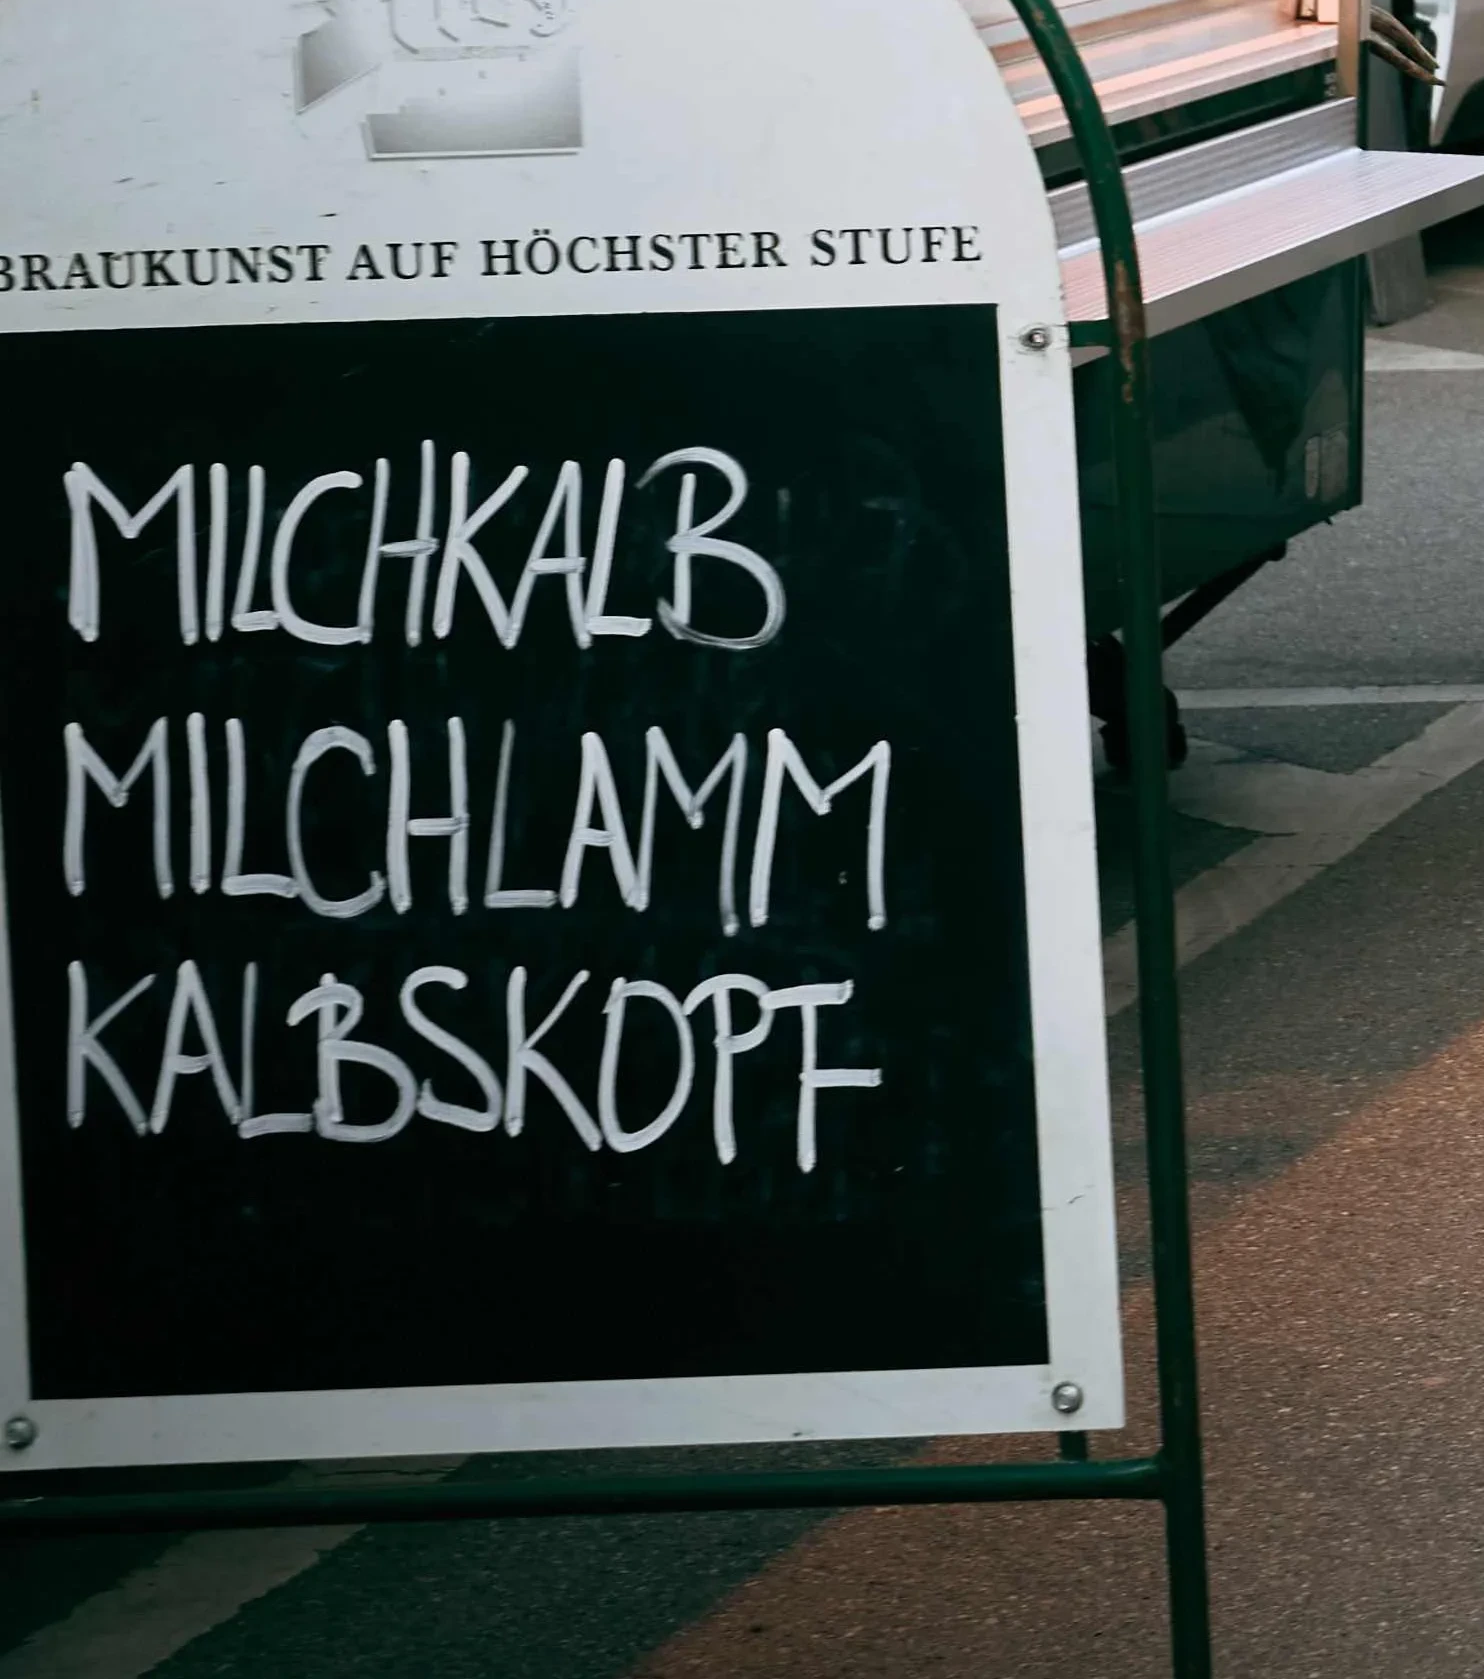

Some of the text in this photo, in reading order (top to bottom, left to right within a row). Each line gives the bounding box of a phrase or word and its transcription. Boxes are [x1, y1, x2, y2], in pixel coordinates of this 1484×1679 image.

[0, 224, 984, 292] BRAUKUNST AUF HÖCHSTER STUFE
[64, 439, 786, 650] MILCHKALB
[62, 711, 892, 936] MILCHLAMM
[67, 959, 883, 1172] KALBSKOPF
